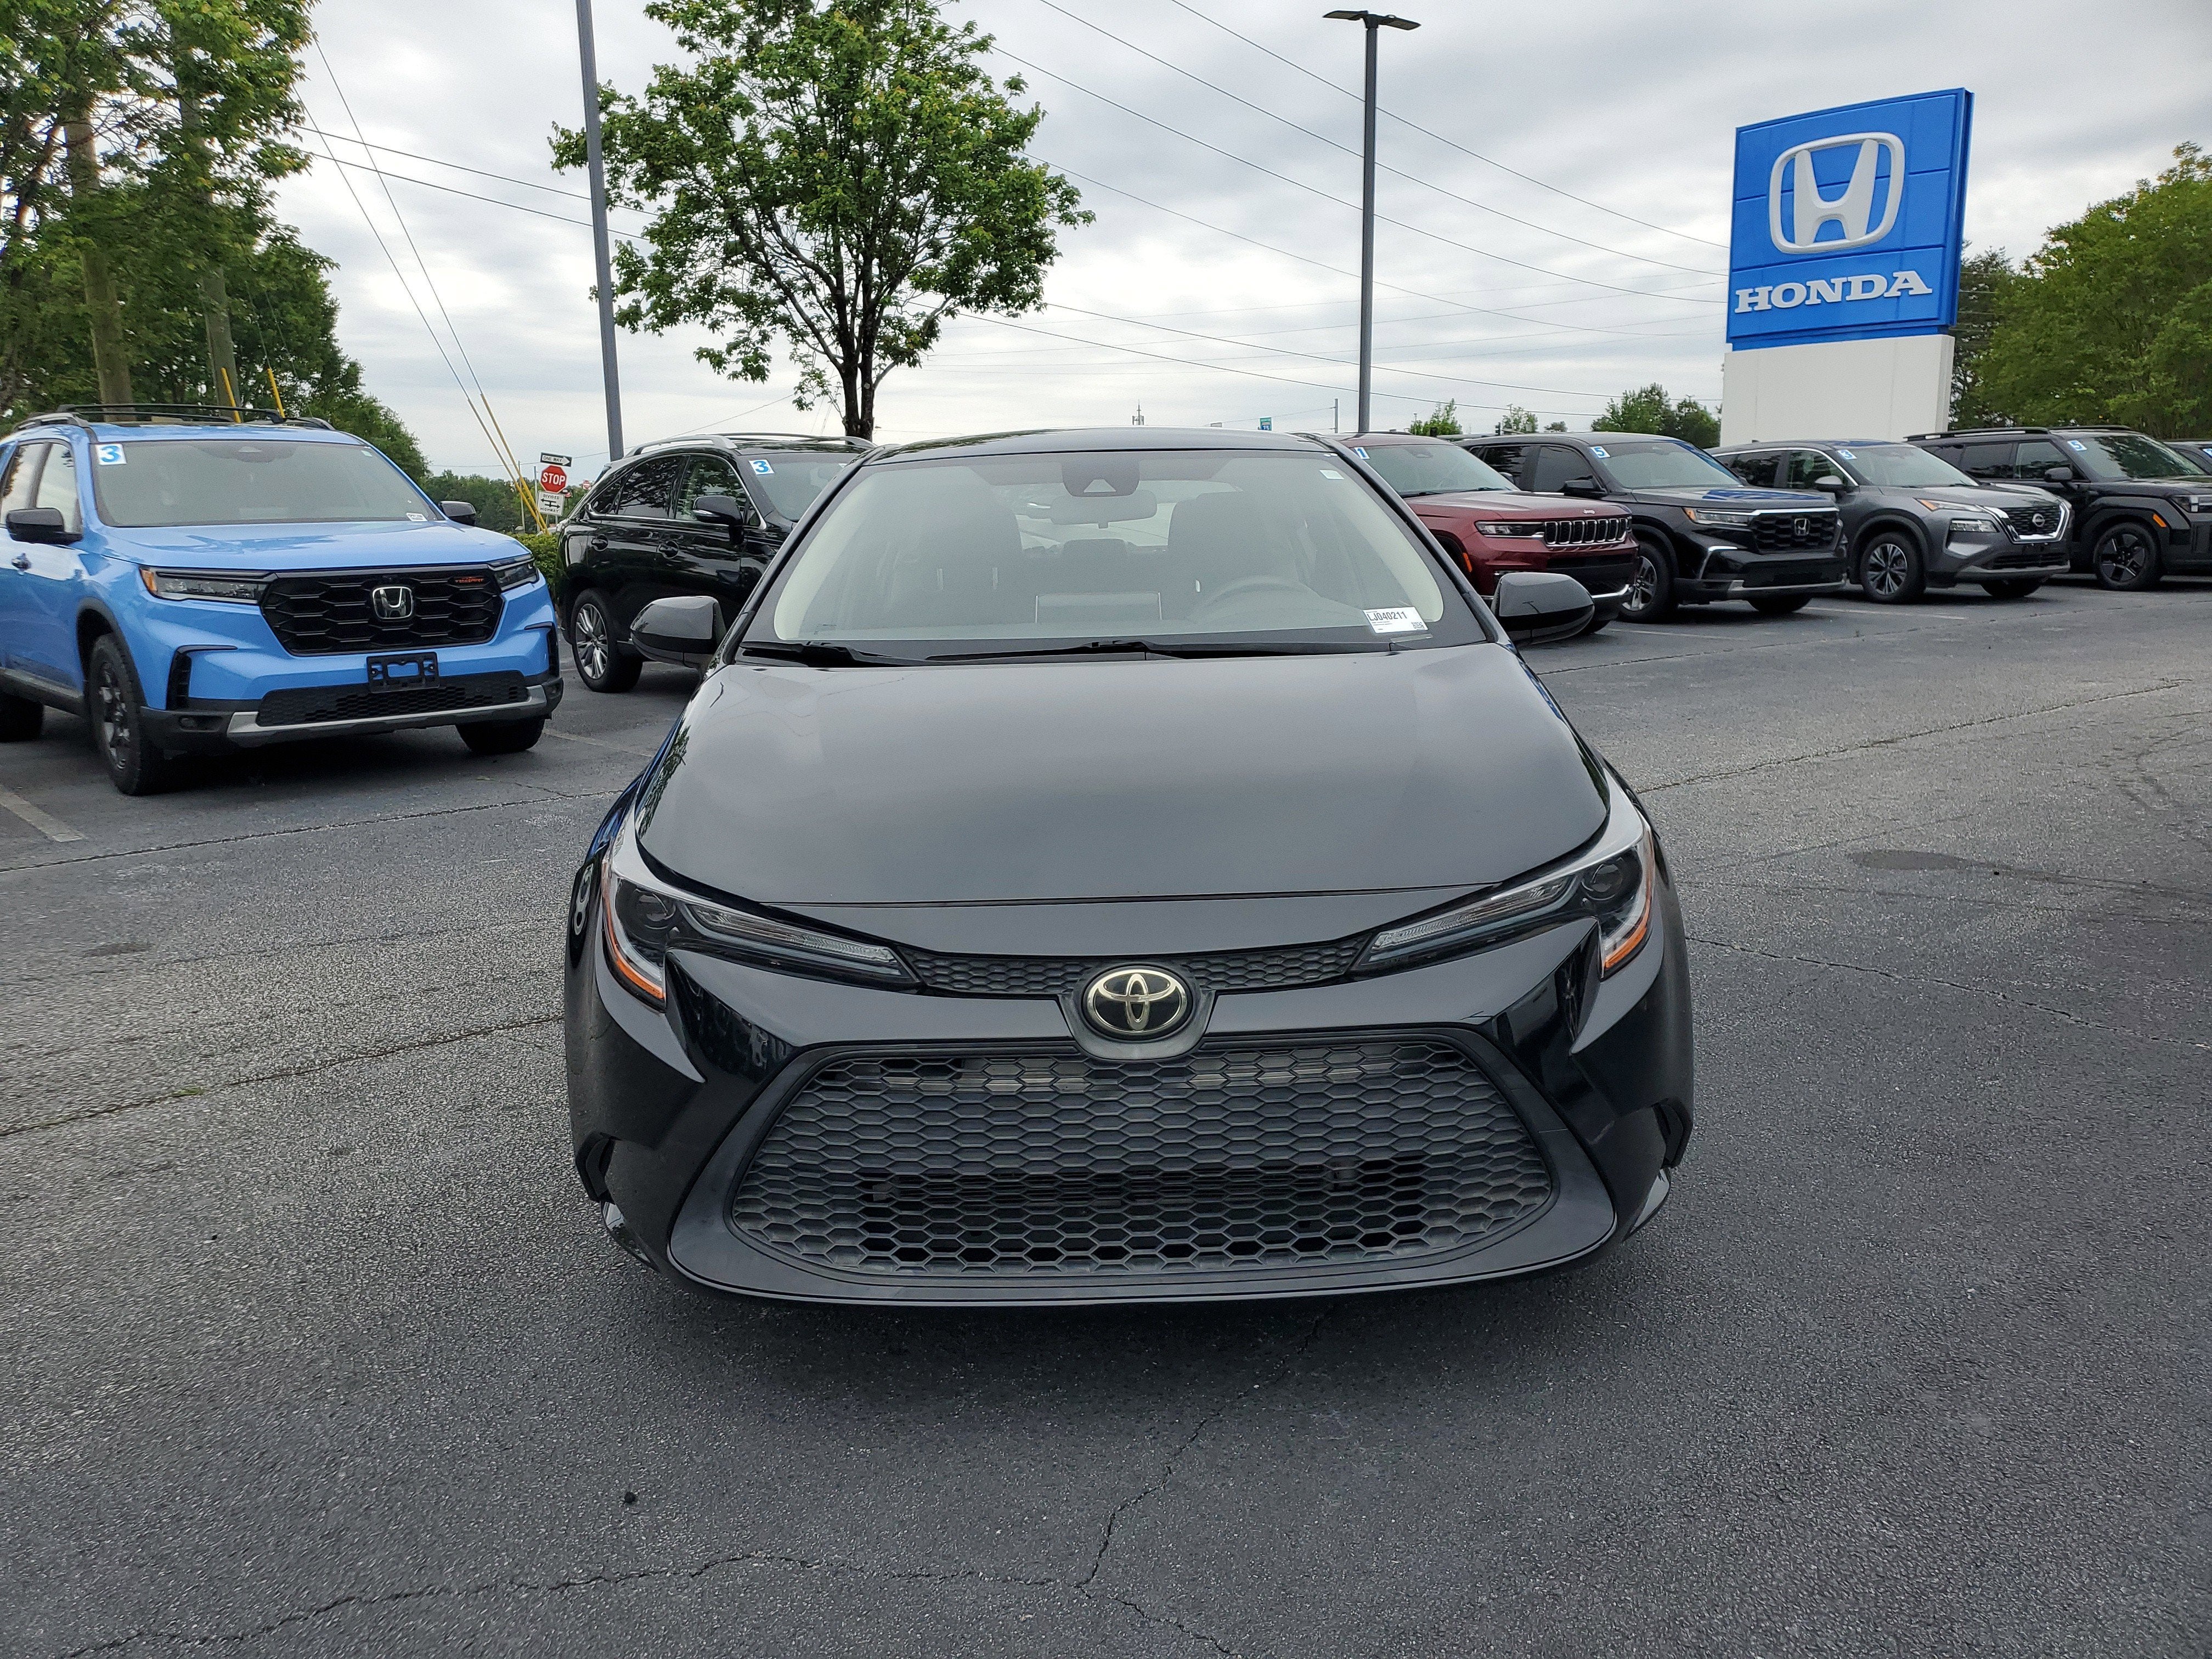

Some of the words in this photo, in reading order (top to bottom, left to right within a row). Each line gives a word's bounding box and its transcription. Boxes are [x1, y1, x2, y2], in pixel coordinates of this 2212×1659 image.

[1734, 270, 1933, 313] HONDA
[100, 445, 120, 462] 3
[1357, 448, 1367, 458] 1
[1594, 447, 1605, 456] 5
[753, 460, 769, 472] 3
[542, 472, 566, 486] STOP
[1367, 611, 1407, 620] LJ040211
